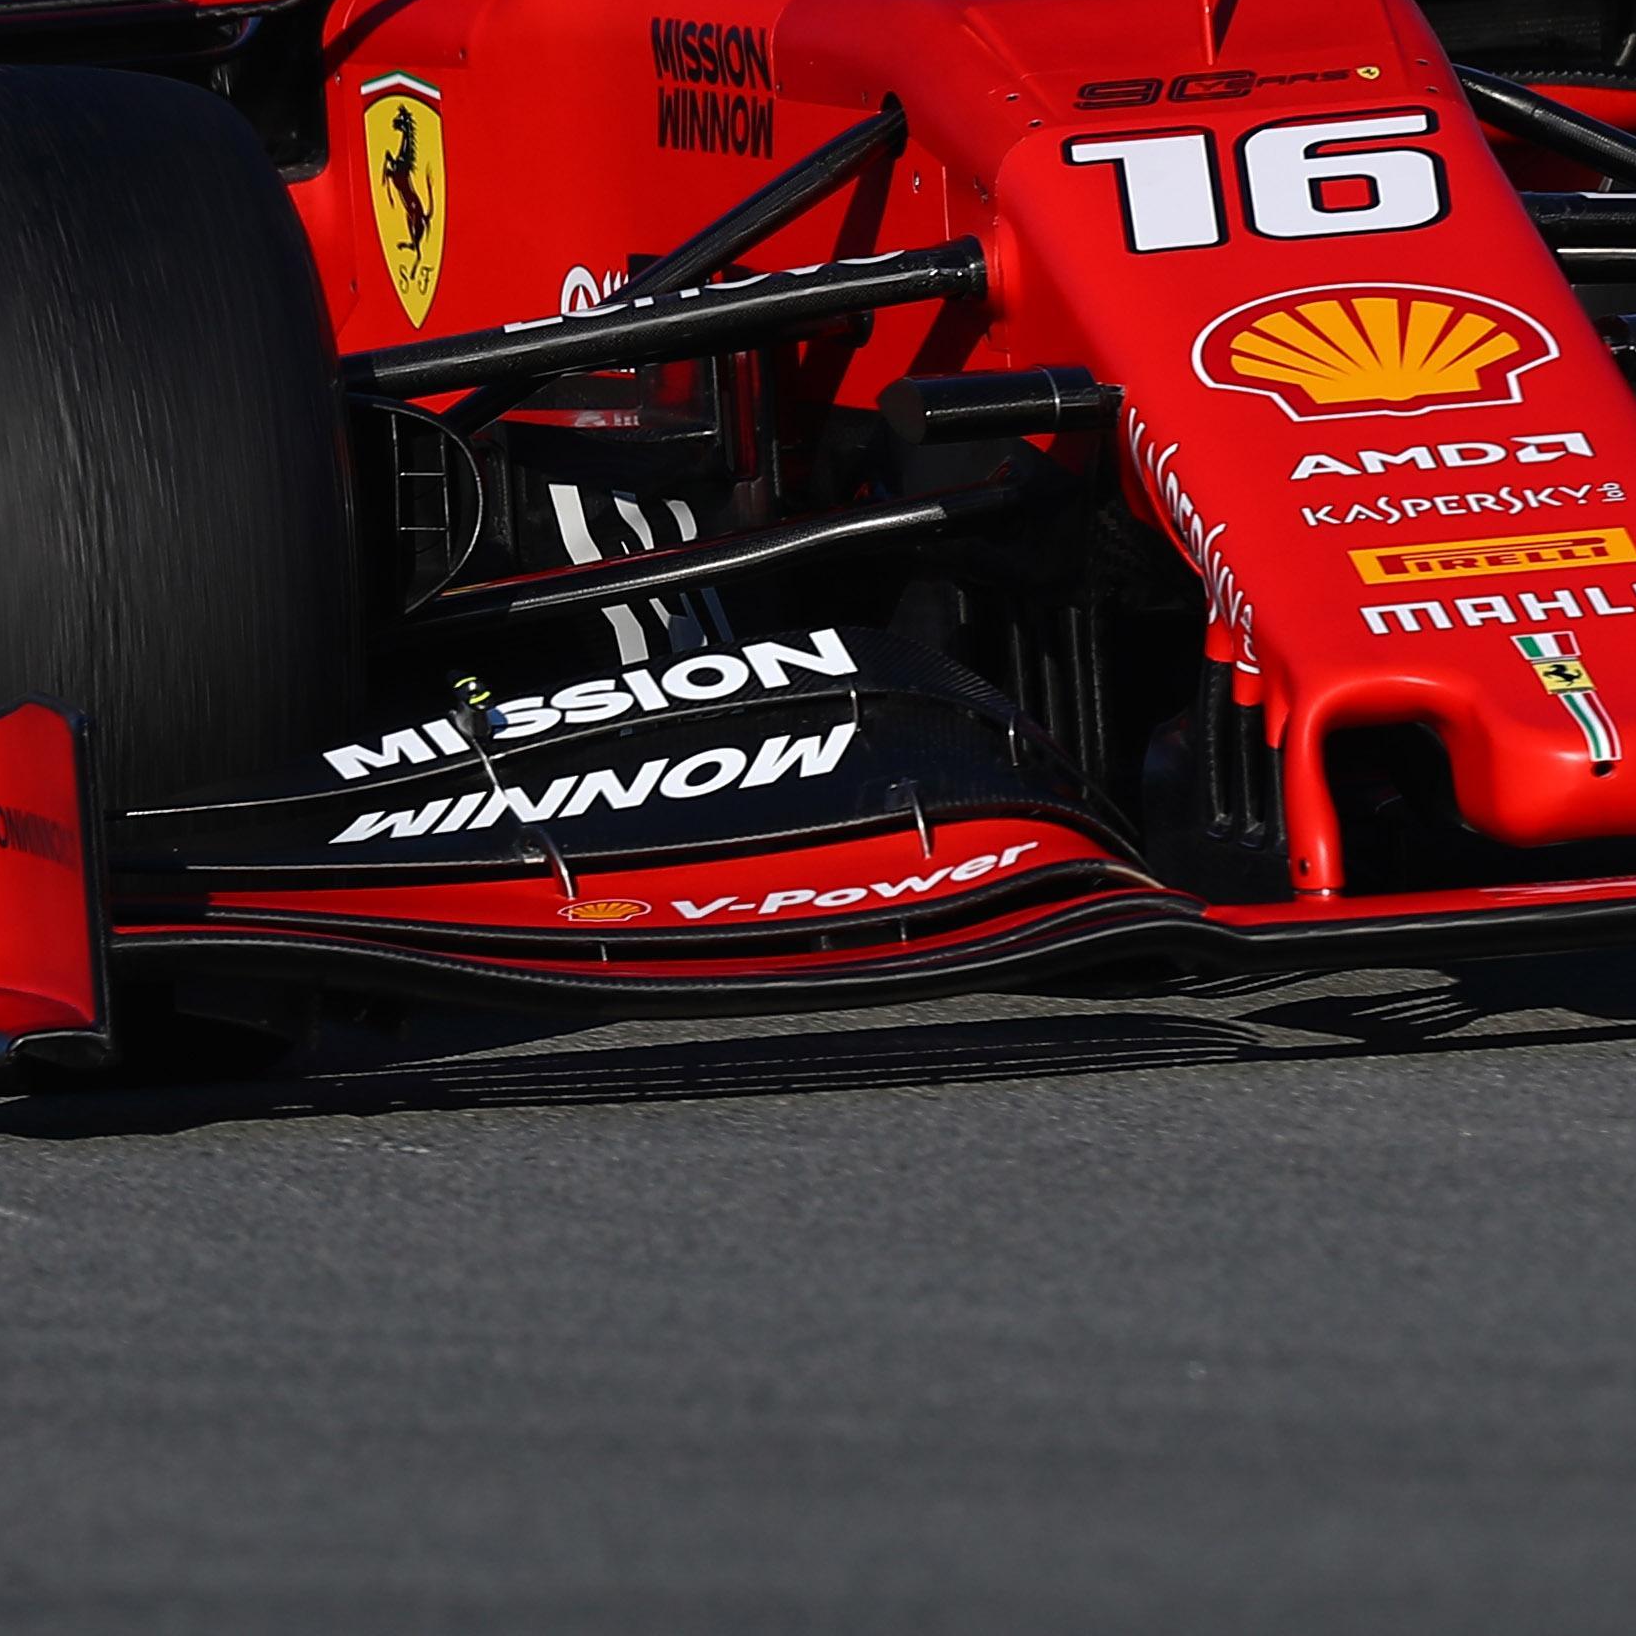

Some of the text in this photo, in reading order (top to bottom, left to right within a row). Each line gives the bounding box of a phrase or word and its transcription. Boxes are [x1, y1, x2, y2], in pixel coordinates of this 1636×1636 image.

[651, 17, 774, 91] MISSION
[656, 86, 774, 161] WINNOW
[1063, 107, 1450, 254] 16
[1290, 441, 1514, 481] AMD
[1301, 481, 1627, 528] KASPERSKY lab
[1374, 535, 1614, 576] PIRELLI
[322, 626, 861, 781] MISSION
[328, 722, 859, 845] WINNOW
[670, 839, 1041, 920] V-Power
